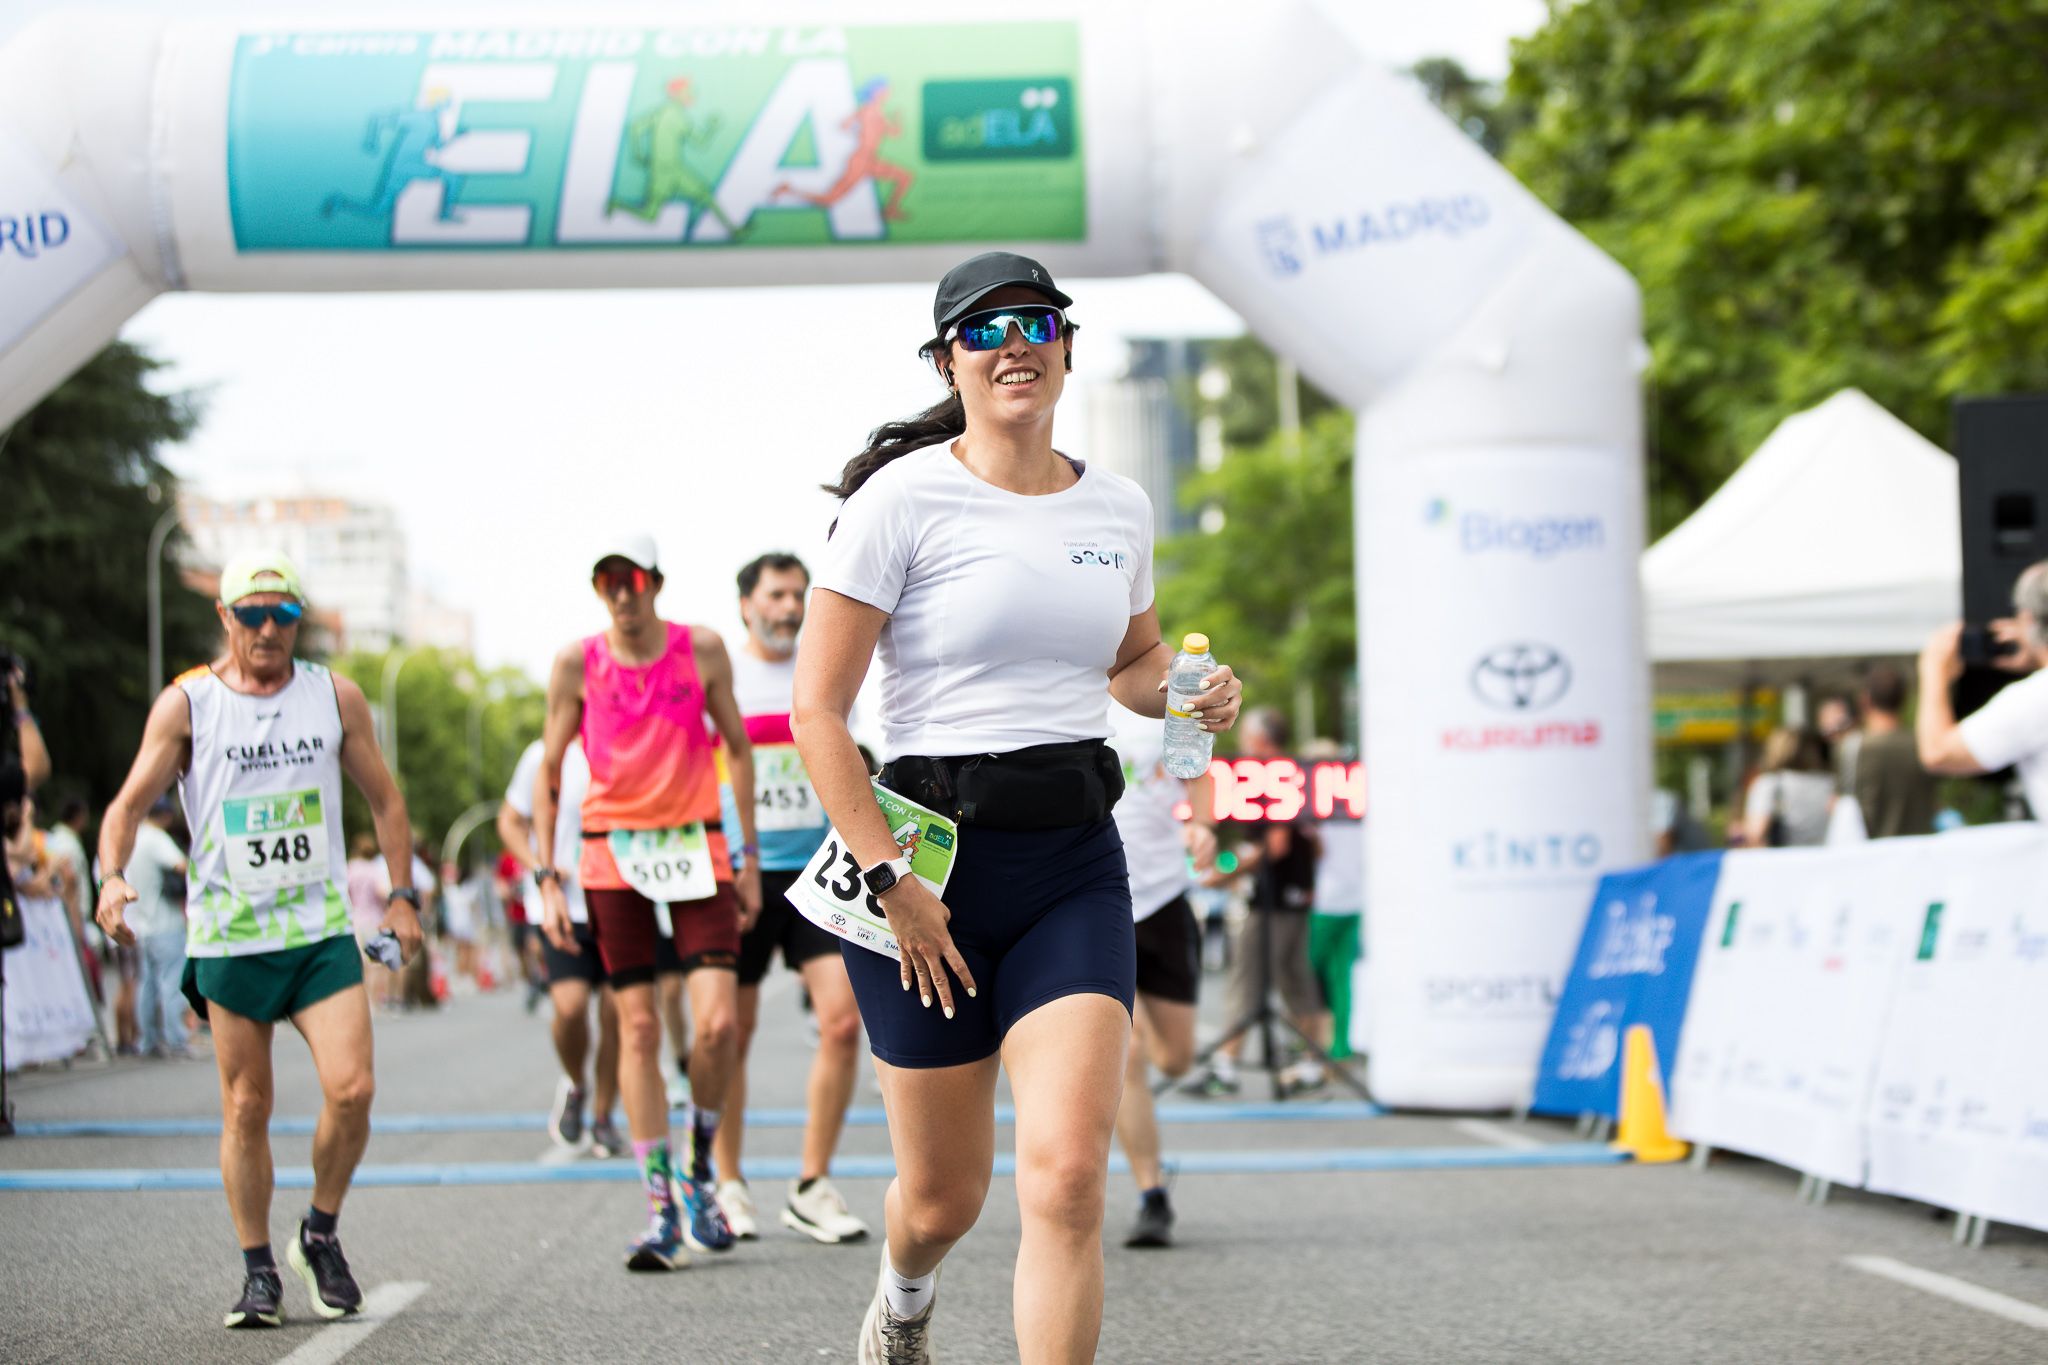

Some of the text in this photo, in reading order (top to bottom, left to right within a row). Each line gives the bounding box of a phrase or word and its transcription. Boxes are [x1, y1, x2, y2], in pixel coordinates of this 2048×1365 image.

[430, 28, 645, 59] MADRID
[651, 26, 770, 56] CON
[778, 22, 848, 55] LA
[391, 61, 887, 246] ELA
[1460, 512, 1604, 557] Biogen
[226, 737, 324, 761] CUELLAR
[246, 798, 305, 832] ELA
[755, 786, 808, 811] 453
[885, 801, 921, 821] CON LA
[247, 834, 311, 868] 348
[633, 859, 692, 883] 509
